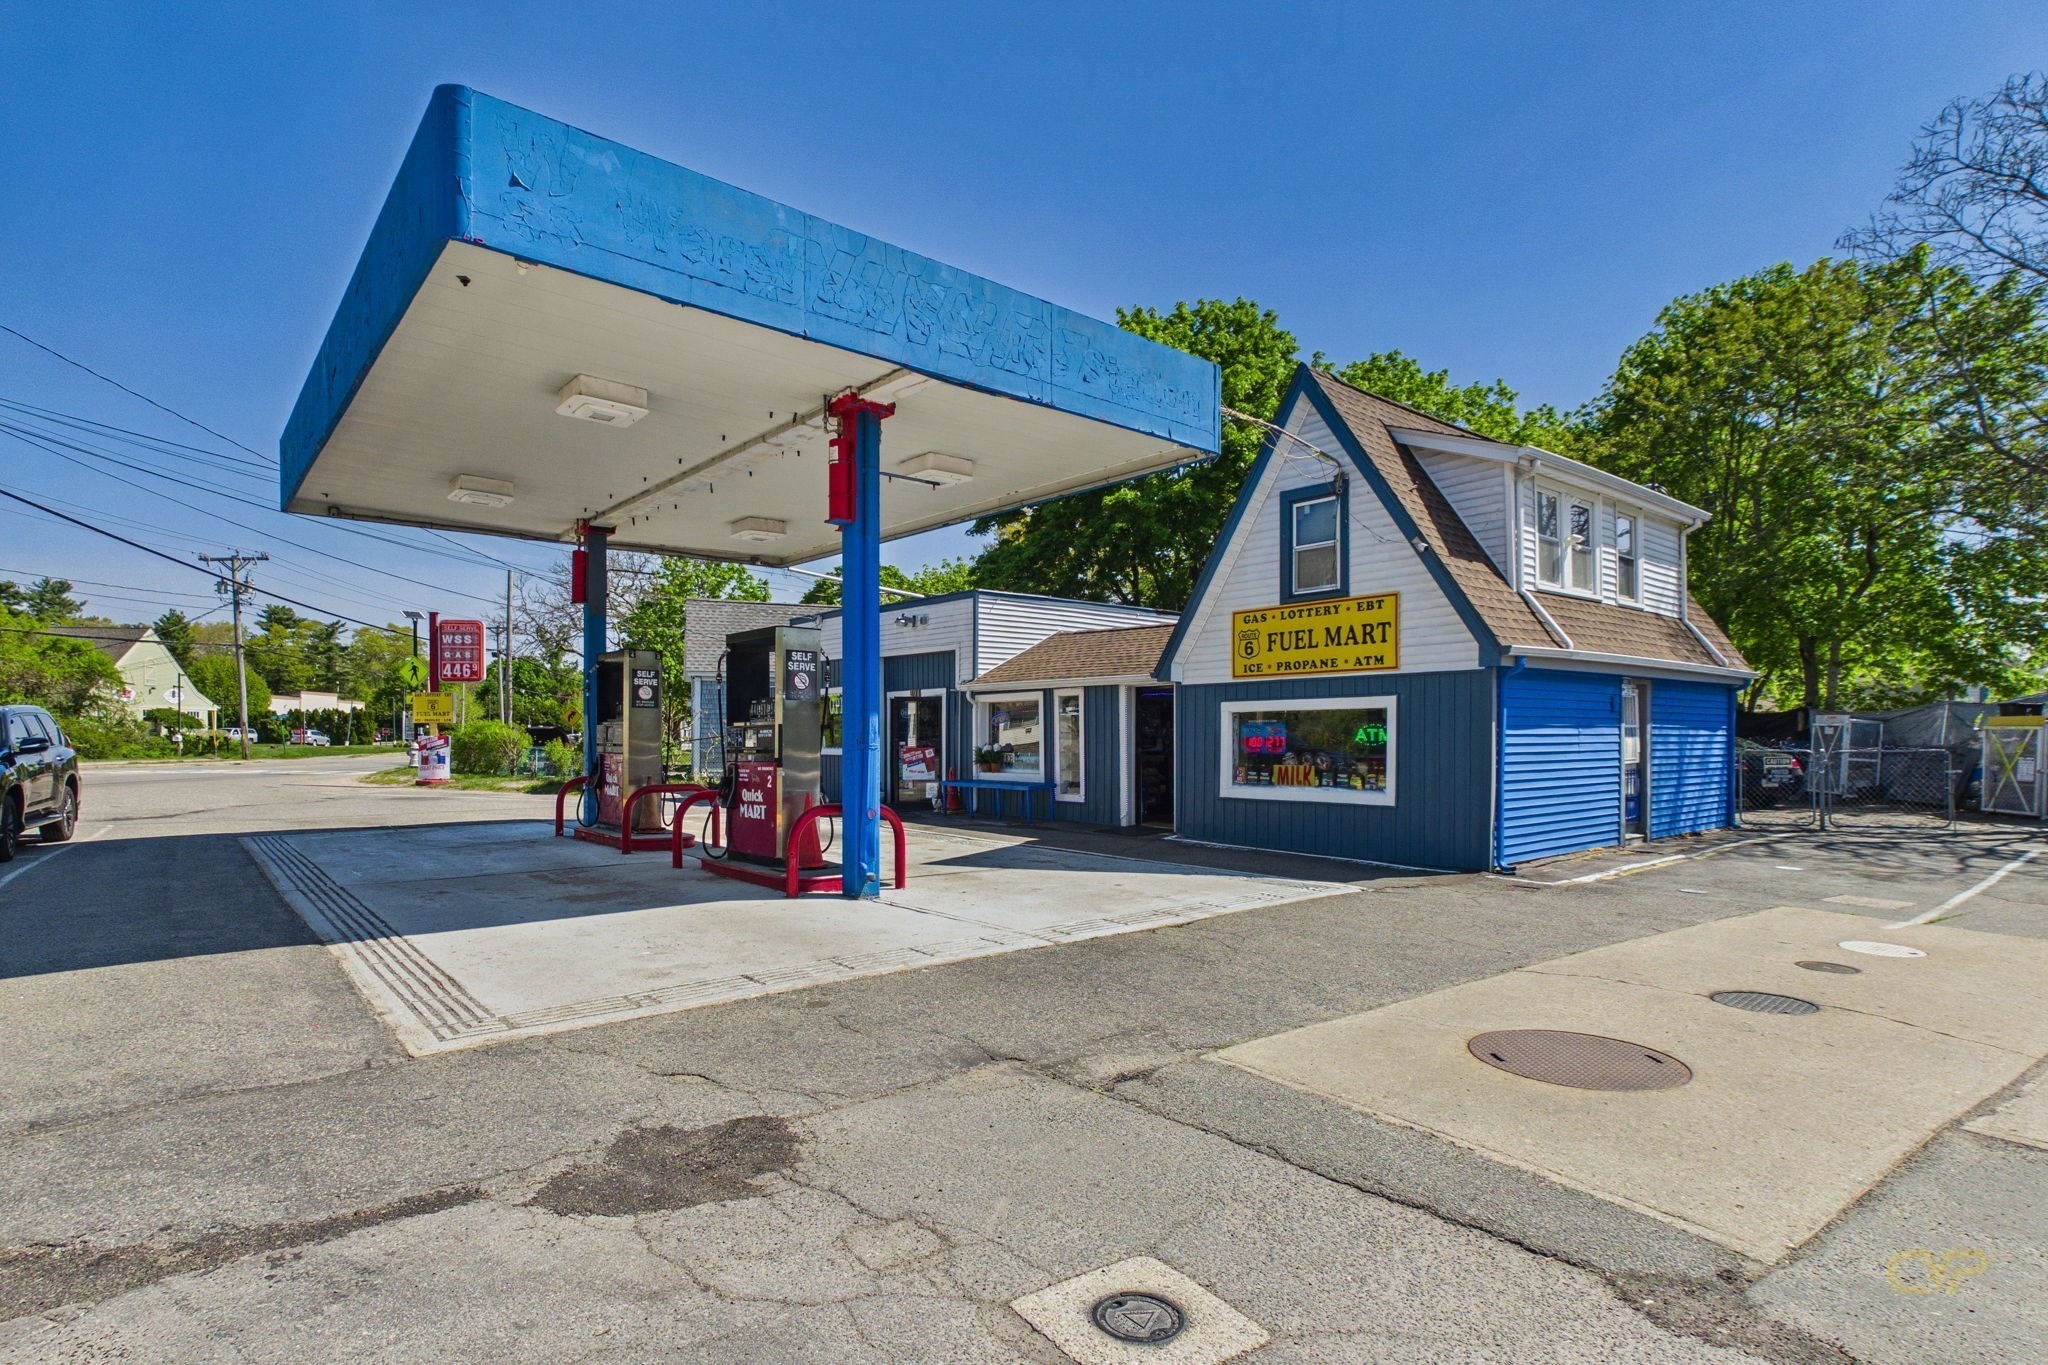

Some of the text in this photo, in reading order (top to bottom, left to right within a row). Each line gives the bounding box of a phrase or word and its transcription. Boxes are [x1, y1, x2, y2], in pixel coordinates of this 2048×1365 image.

[1243, 600, 1385, 624] GAS LOTTERY EBT
[442, 634, 472, 644] WSS
[1267, 622, 1392, 652] FUEL MART
[1244, 641, 1254, 656] 6
[791, 652, 813, 662] SELF
[788, 662, 816, 672] SERVE
[1243, 655, 1385, 674] ICE PROPANE ATM
[634, 678, 658, 686] SERVE
[767, 775, 772, 788] 2
[1277, 766, 1312, 786] MILK
[605, 784, 620, 797] MART
[742, 788, 764, 802] Quick
[740, 804, 767, 820] MART
